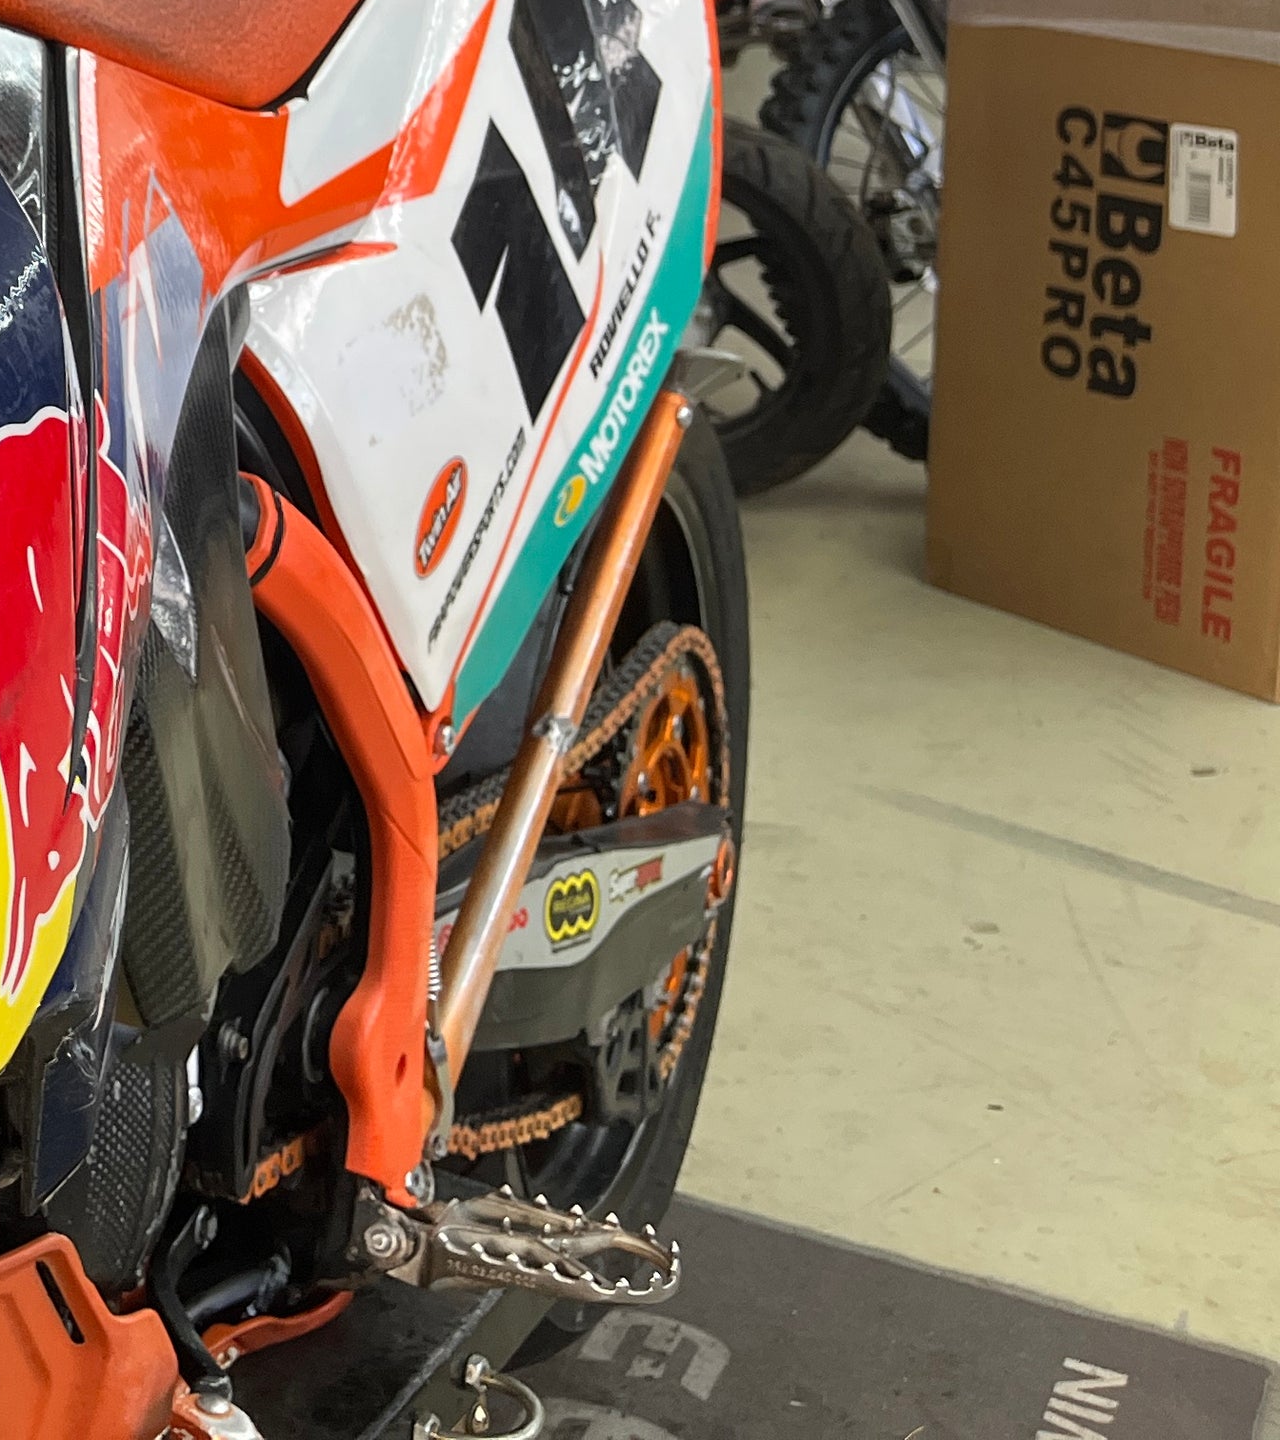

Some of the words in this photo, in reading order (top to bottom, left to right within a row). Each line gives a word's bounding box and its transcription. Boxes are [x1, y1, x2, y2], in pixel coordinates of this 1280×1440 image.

[590, 235, 650, 380] ROVIELLO
[1042, 107, 1098, 379] C45PRO
[1087, 193, 1163, 398] Beta
[578, 307, 670, 485] MOTOREX
[1201, 446, 1242, 644] FRAGILE
